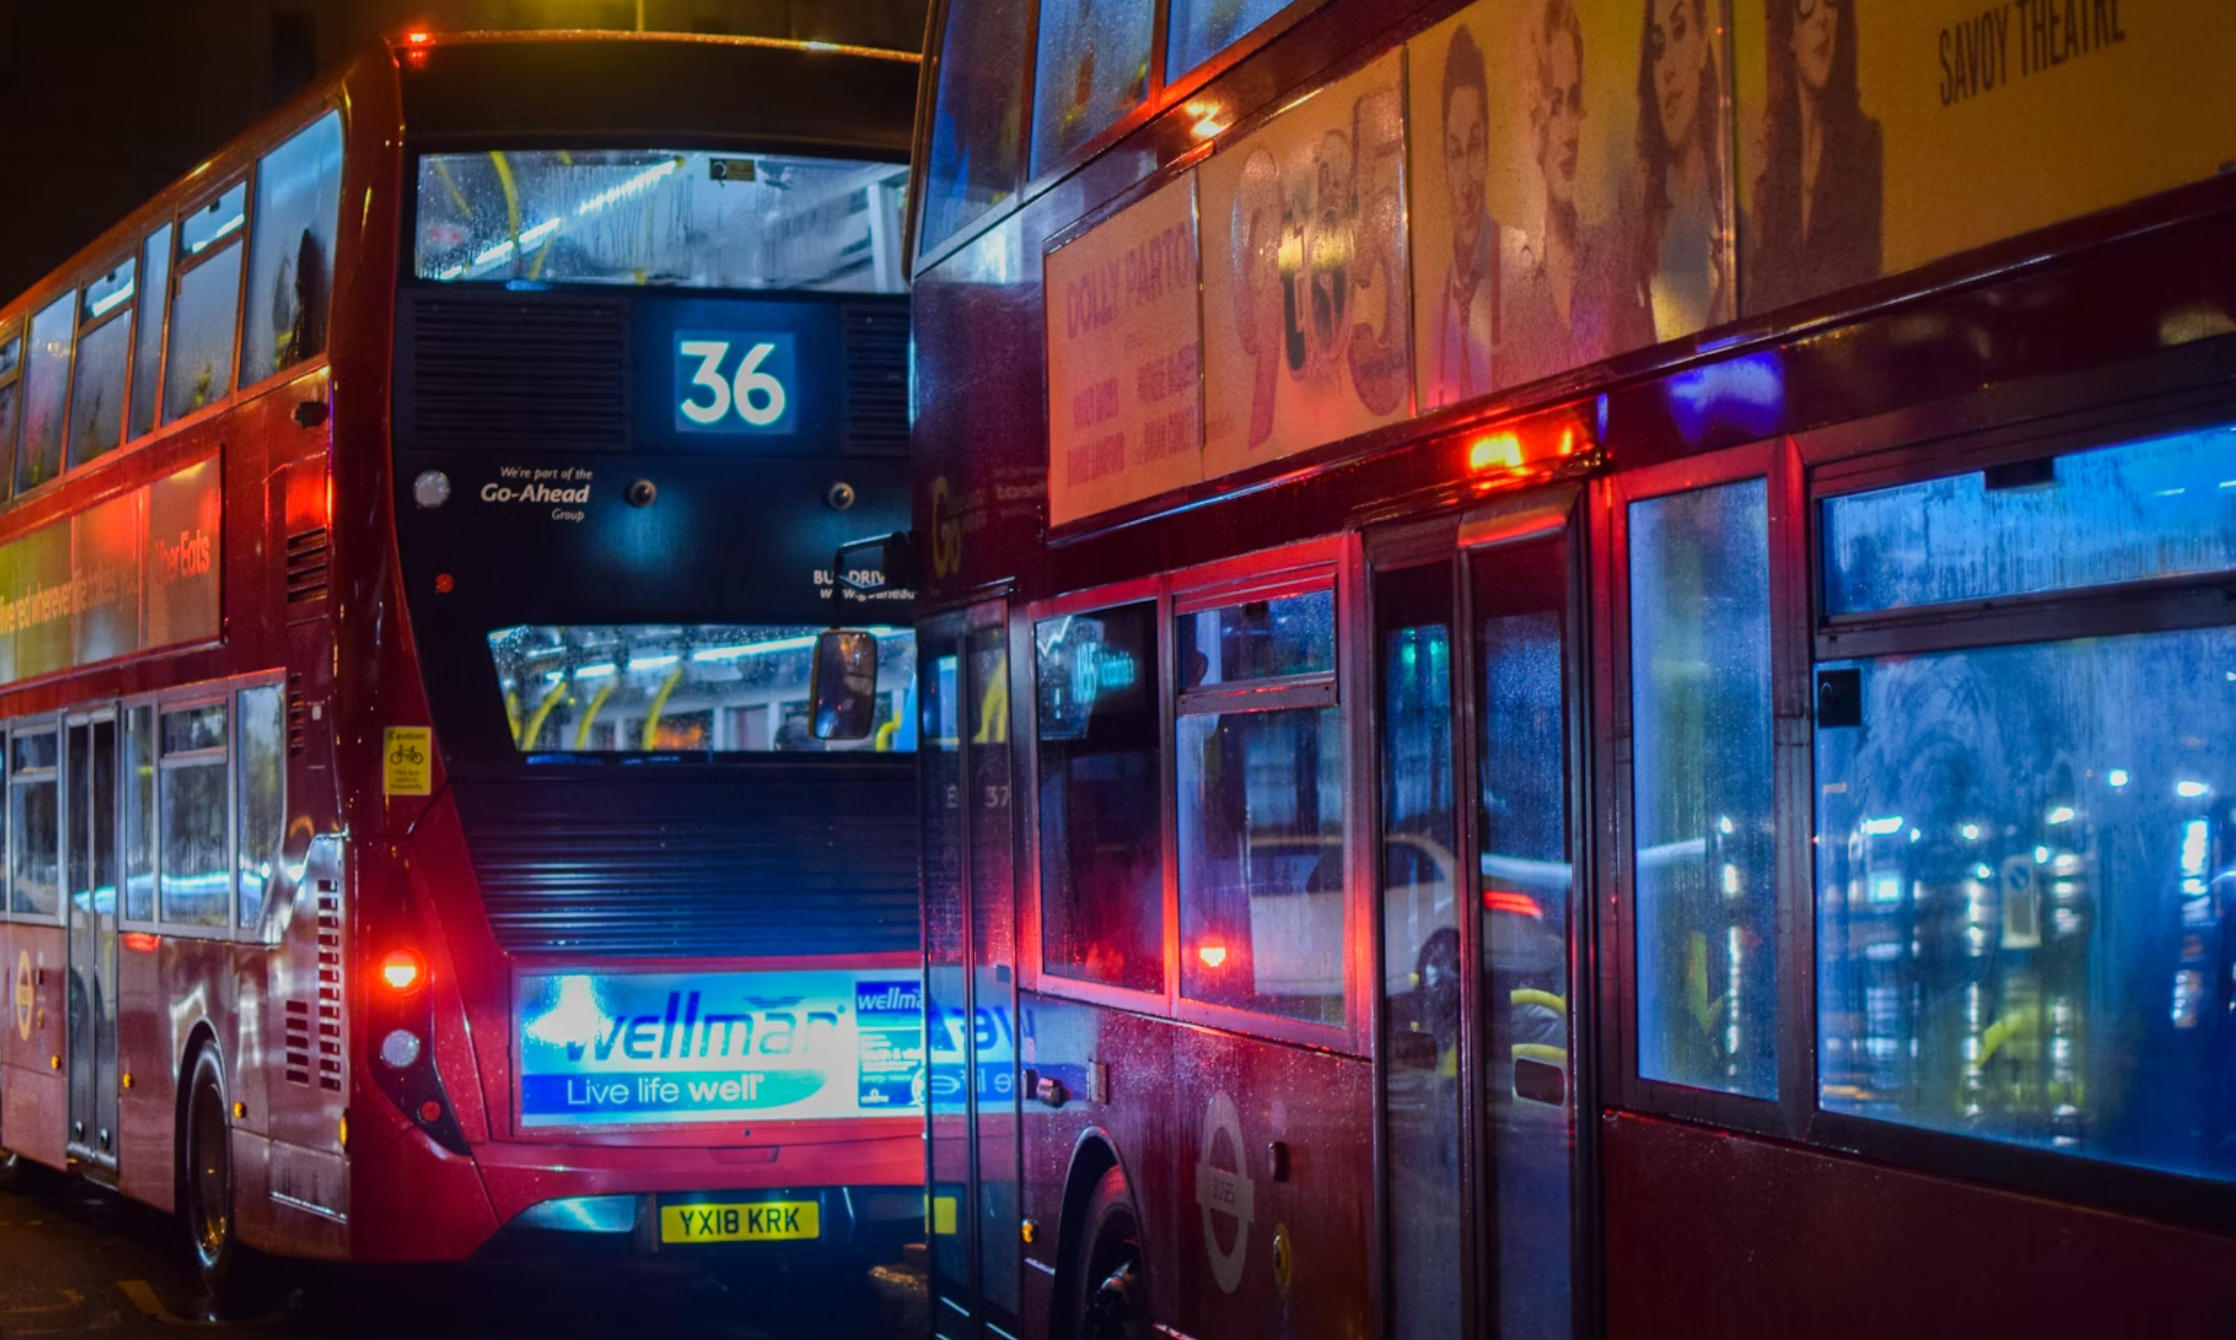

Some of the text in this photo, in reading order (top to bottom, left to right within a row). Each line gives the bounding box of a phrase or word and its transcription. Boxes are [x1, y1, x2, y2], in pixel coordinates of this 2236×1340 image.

[1939, 0, 2126, 109] SAVOY THEATRE
[1067, 256, 1119, 339] DOLLY
[681, 341, 785, 424] 36
[500, 466, 593, 481] We're part of the
[480, 483, 591, 503] Go-Ahead
[551, 508, 585, 523] Group
[848, 570, 885, 585] DRIV
[858, 987, 922, 1010] wellma
[567, 1079, 629, 1105] Live
[638, 1077, 680, 1103] life
[679, 1207, 800, 1236] YX18 KRK
